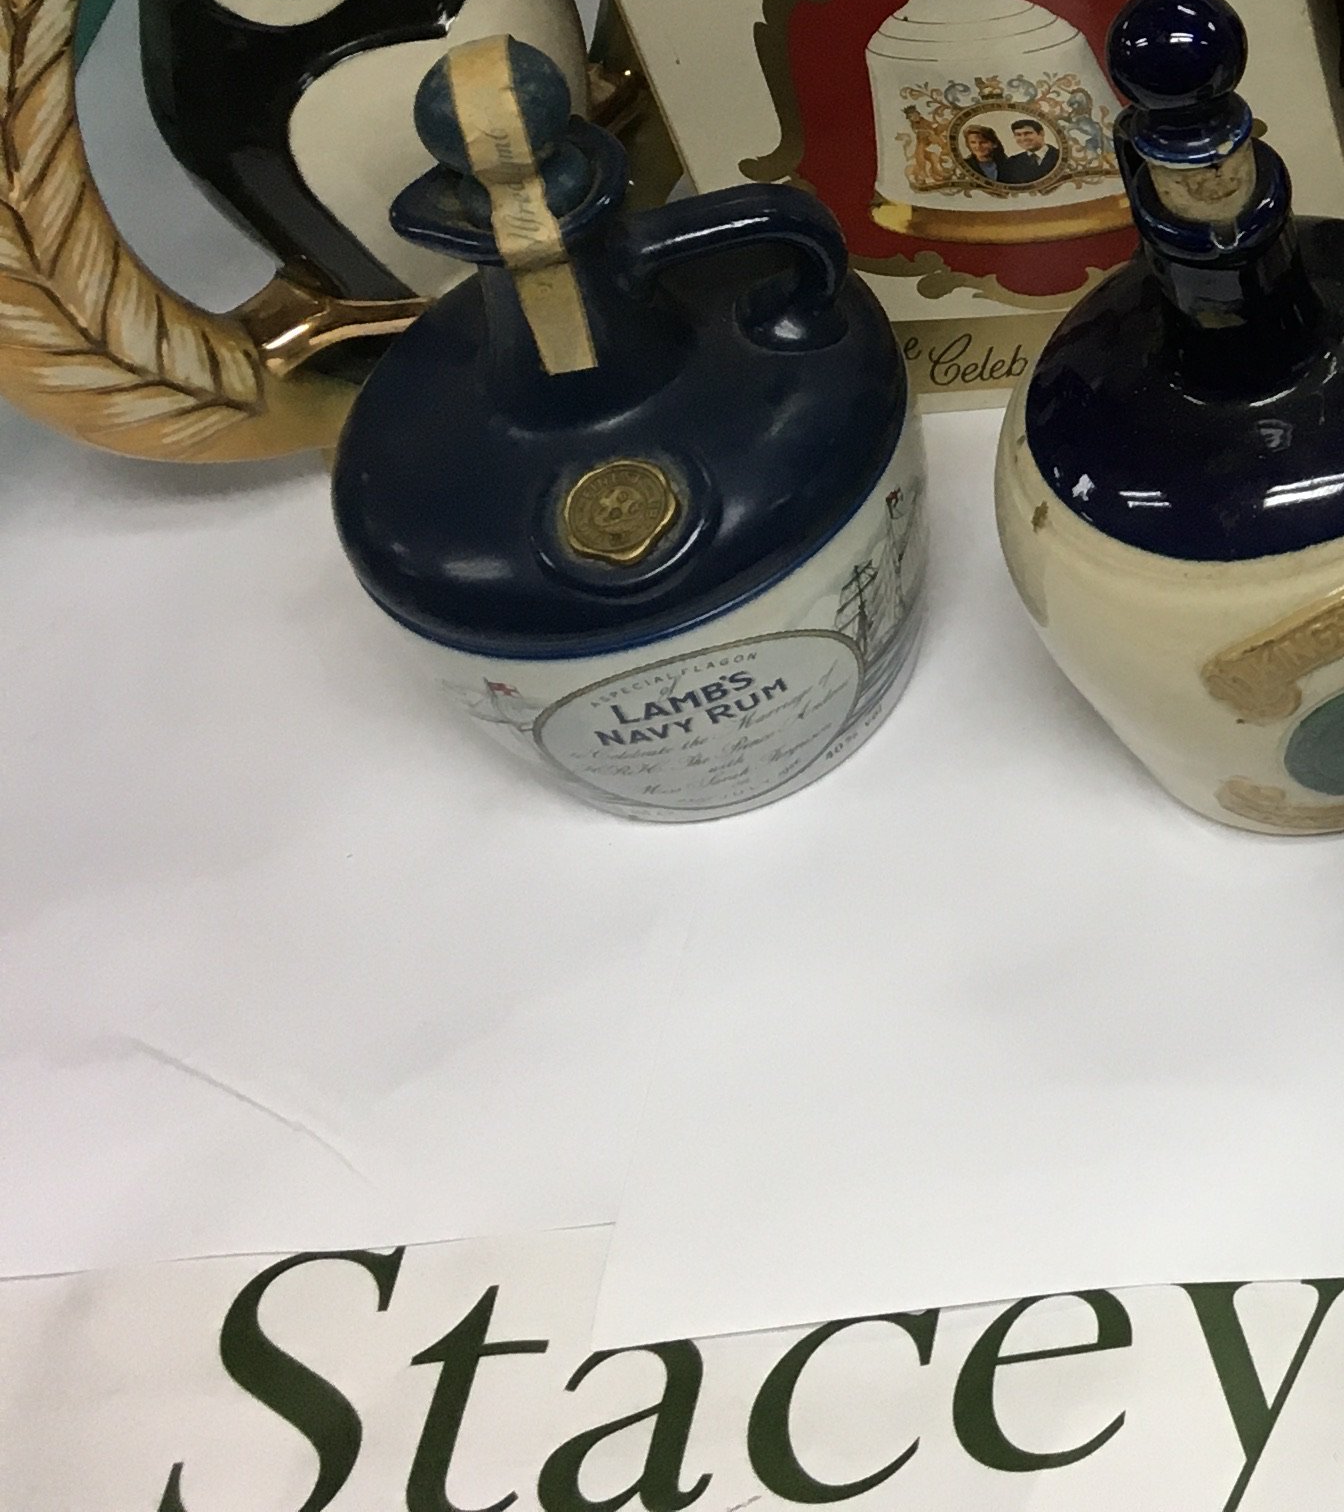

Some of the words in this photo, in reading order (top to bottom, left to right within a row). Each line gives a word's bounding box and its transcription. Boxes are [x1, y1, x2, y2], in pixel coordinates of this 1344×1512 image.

[929, 333, 1027, 385] Celeb
[681, 651, 758, 675] FLAGON
[594, 717, 693, 747] NAVY
[704, 677, 788, 725] RUM
[611, 670, 754, 725] LAMB'S
